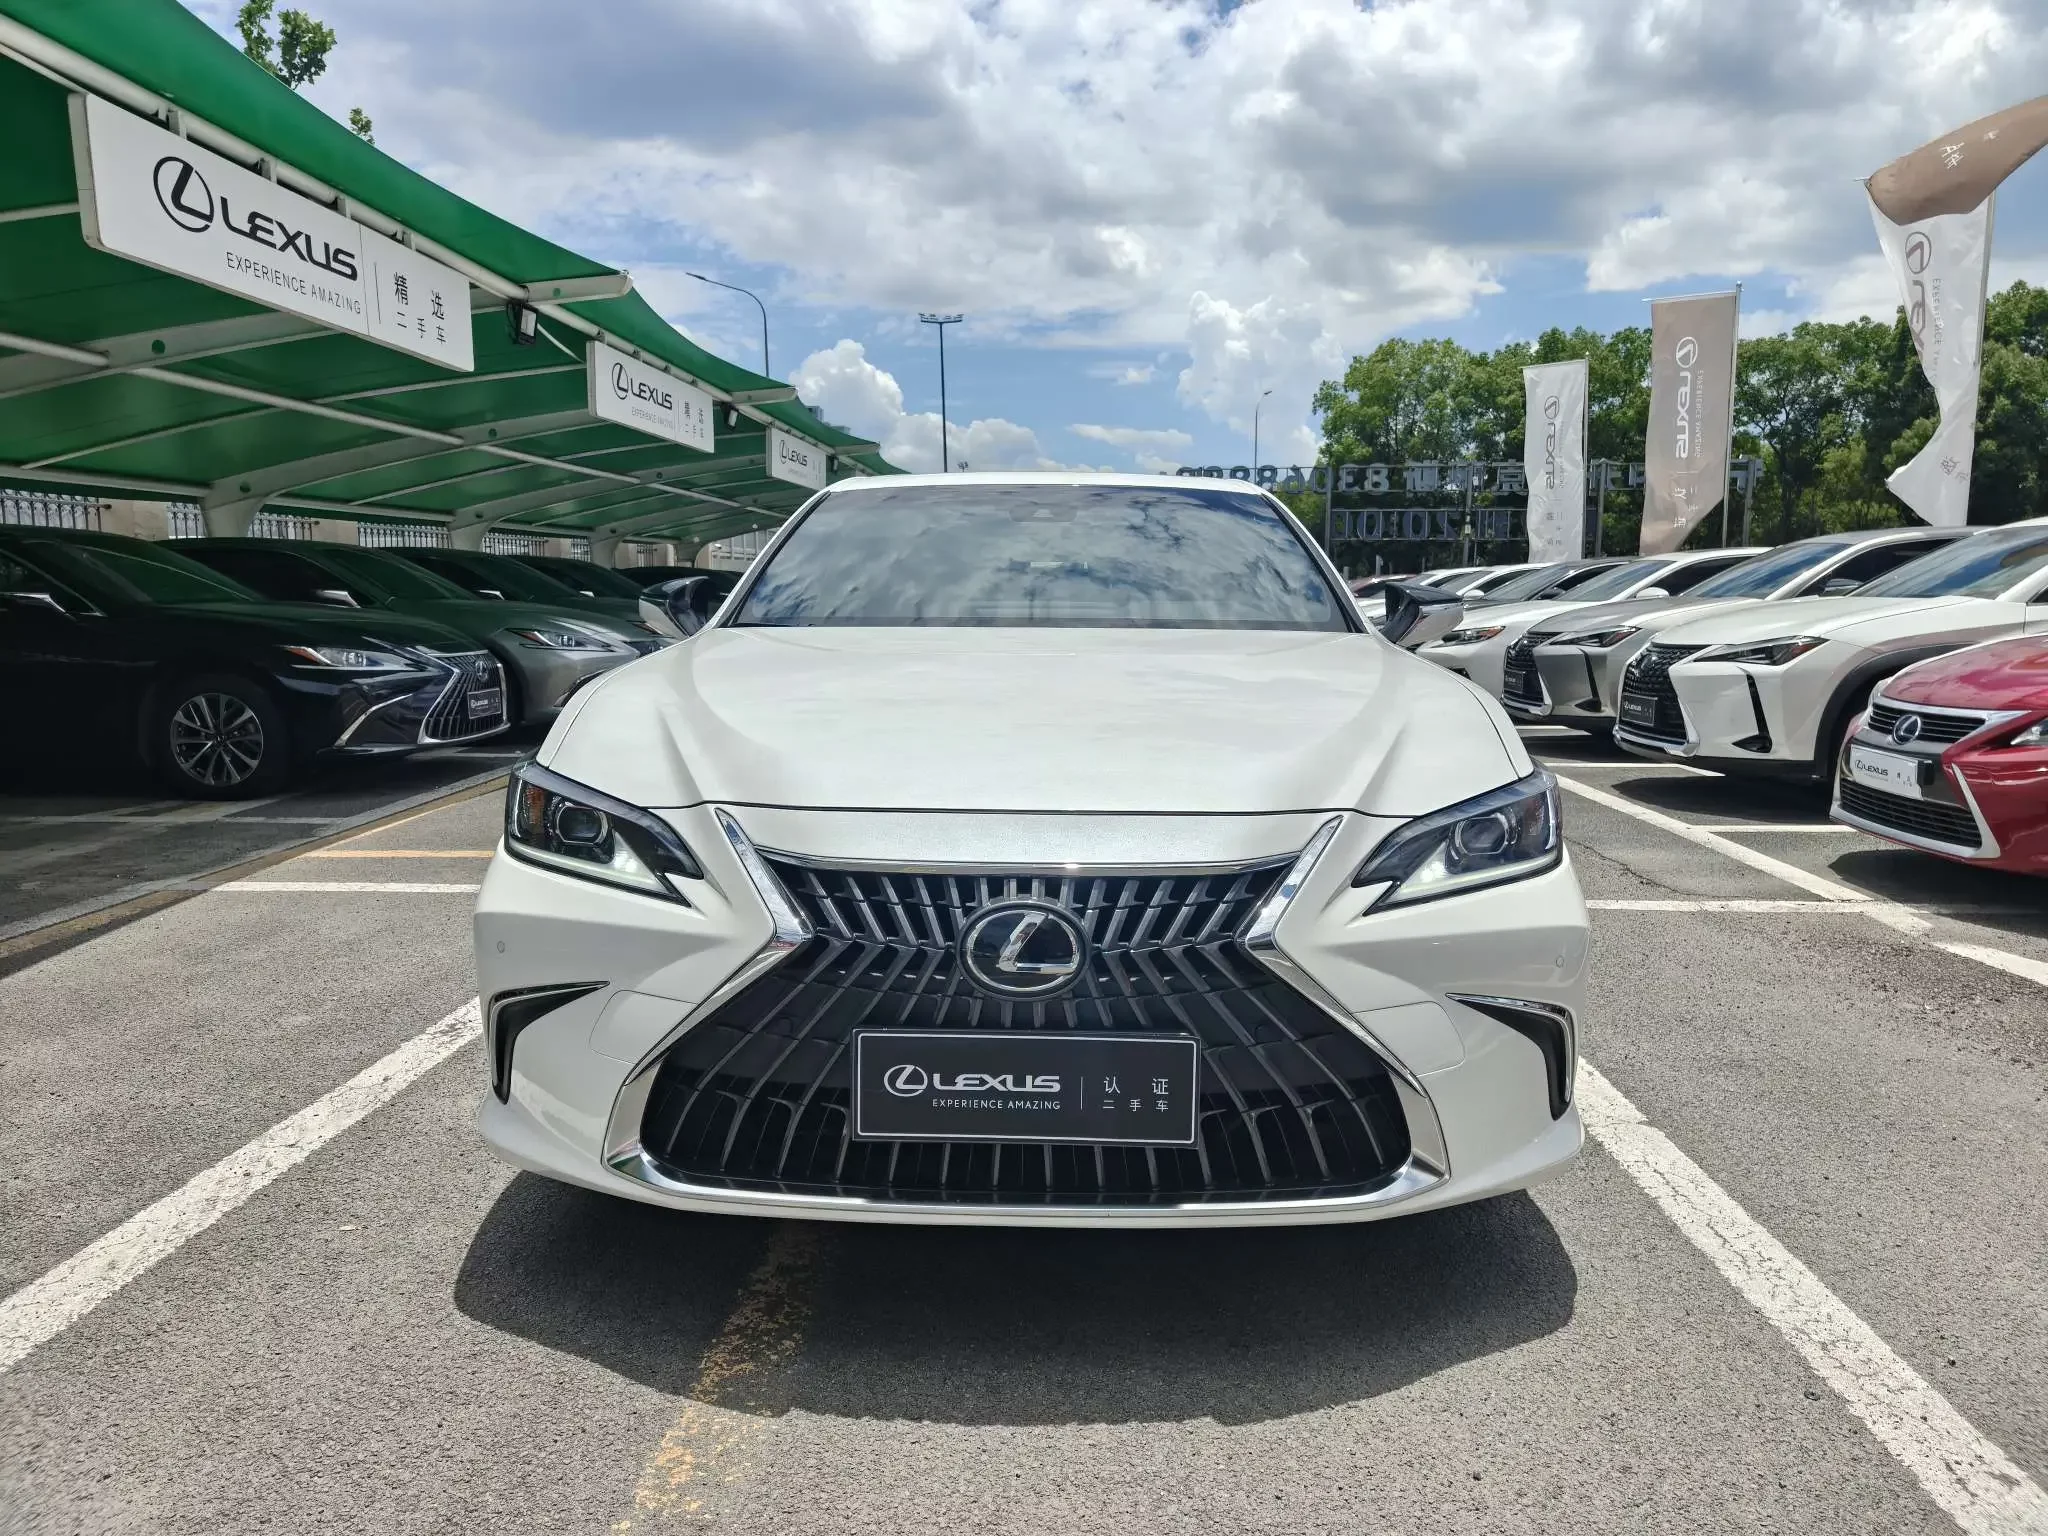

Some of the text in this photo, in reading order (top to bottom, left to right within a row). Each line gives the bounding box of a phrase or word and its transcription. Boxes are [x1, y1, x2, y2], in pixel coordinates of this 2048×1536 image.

[221, 196, 357, 281] LEXUS
[226, 252, 362, 315] EXPERIENCE AMAZING
[394, 272, 444, 320] 精选
[397, 312, 446, 344] 二手车
[630, 377, 672, 410] LEXUS
[788, 448, 808, 467] LEXUS
[1863, 764, 1888, 776] LEXUS
[932, 1073, 1061, 1093] LEXUS
[1104, 1076, 1169, 1095] 认证
[932, 1099, 1061, 1111] EXPERIENCE AMAZING
[1102, 1099, 1169, 1113] 二手车
